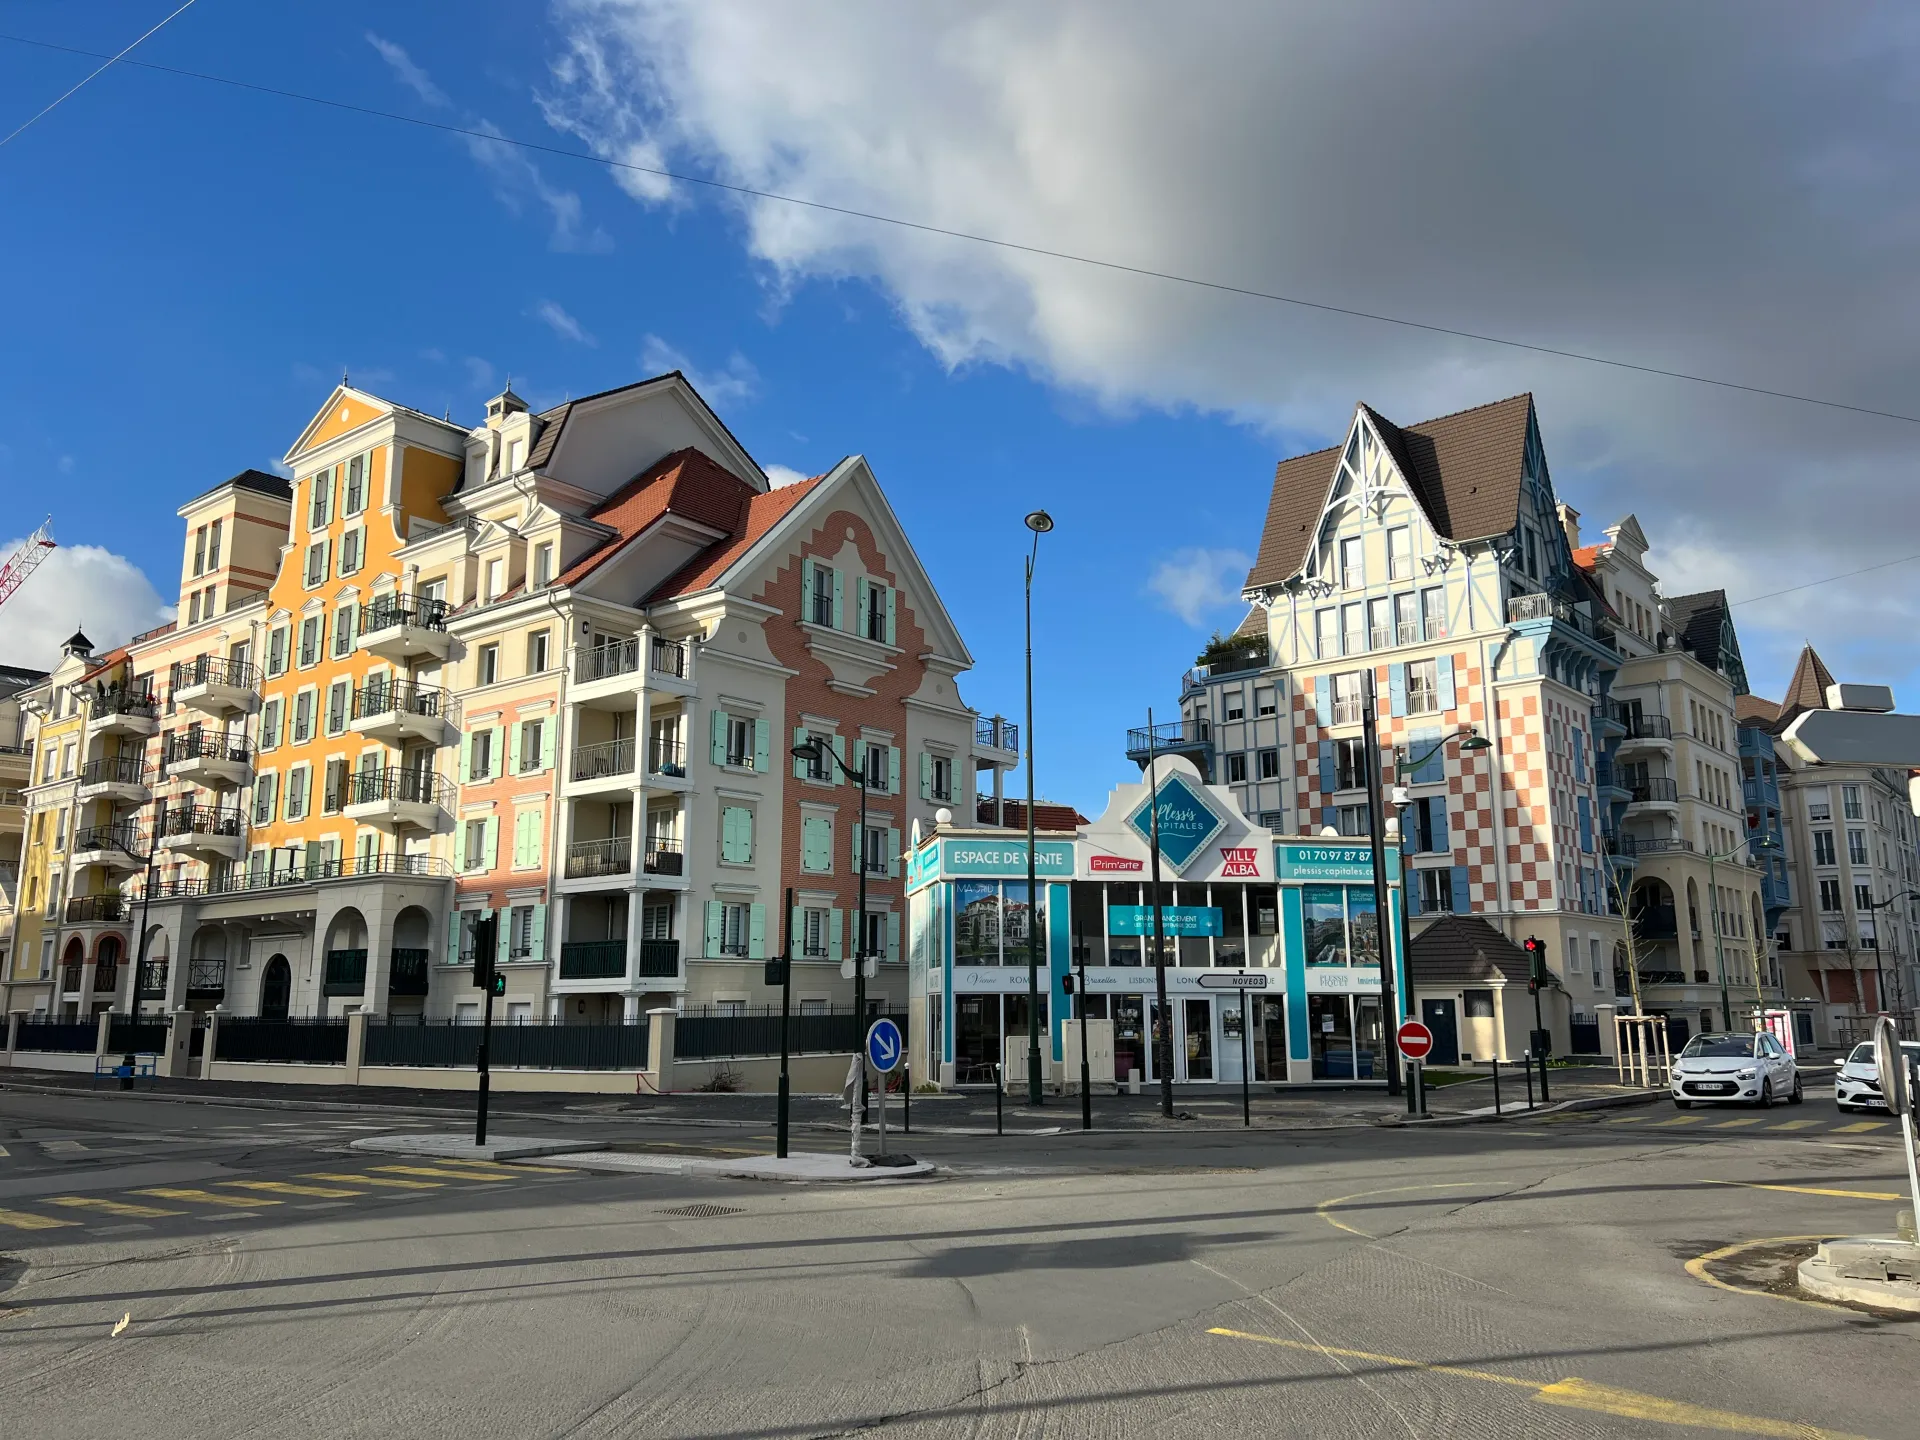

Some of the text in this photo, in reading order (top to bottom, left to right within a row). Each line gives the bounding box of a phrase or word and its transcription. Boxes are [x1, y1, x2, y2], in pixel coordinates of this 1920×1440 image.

[1157, 803, 1197, 822] Plessis
[1157, 822, 1204, 830] APITALES
[954, 851, 1000, 864] ESPACE
[1003, 852, 1020, 865] DE
[1223, 850, 1256, 861] VILL'
[1299, 850, 1371, 862] 01 70 97 87 87
[1093, 860, 1140, 870] Prim'arte
[1224, 864, 1257, 875] ALBA
[1293, 865, 1374, 877] plessis-capitales.co
[966, 970, 1030, 986] Vienne ROM
[1128, 977, 1157, 985] LISBONN
[1232, 977, 1264, 985] NOVEOS
